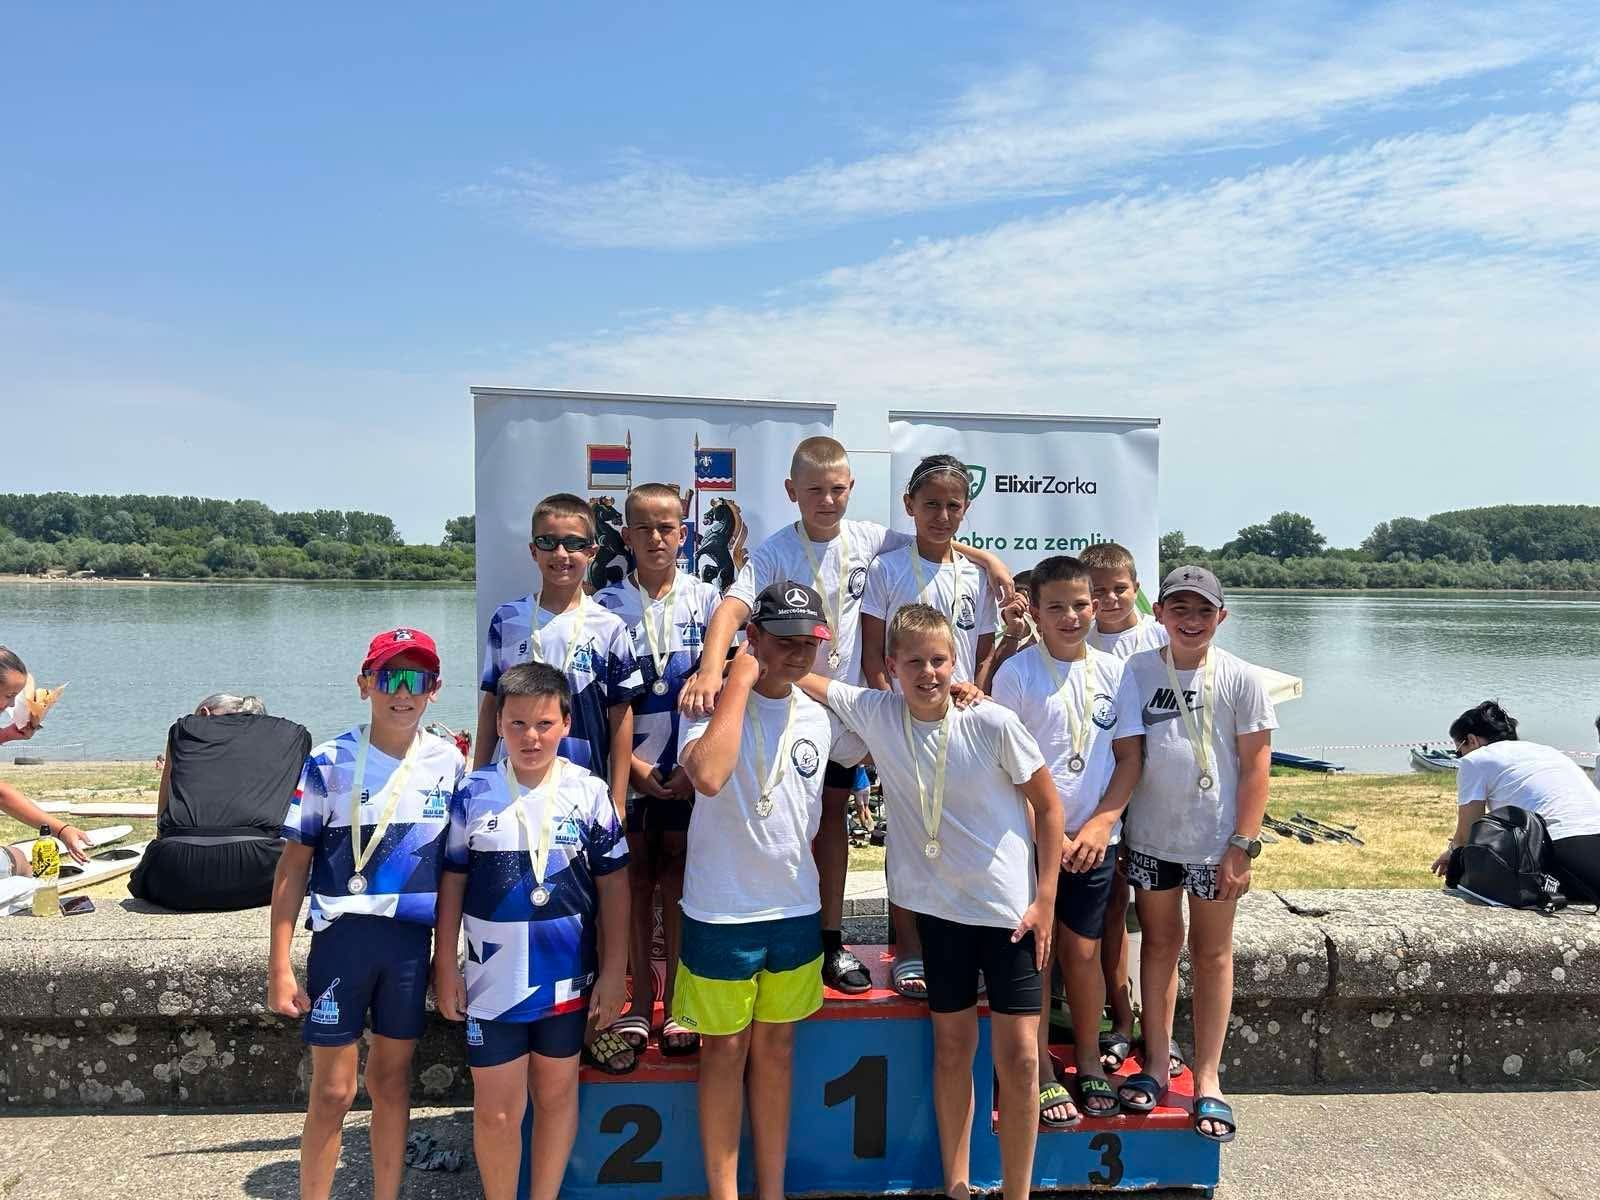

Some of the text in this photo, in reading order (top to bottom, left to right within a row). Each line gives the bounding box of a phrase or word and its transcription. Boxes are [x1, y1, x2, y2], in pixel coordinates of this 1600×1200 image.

[995, 475, 1097, 494] ElixirZorka
[952, 532, 1007, 550] obro
[1013, 538, 1037, 550] za
[1040, 1087, 1069, 1104] FILA
[1081, 1080, 1112, 1092] FILA
[824, 1055, 888, 1159] 1
[598, 1104, 663, 1184] 2
[1088, 1133, 1123, 1186] 3
